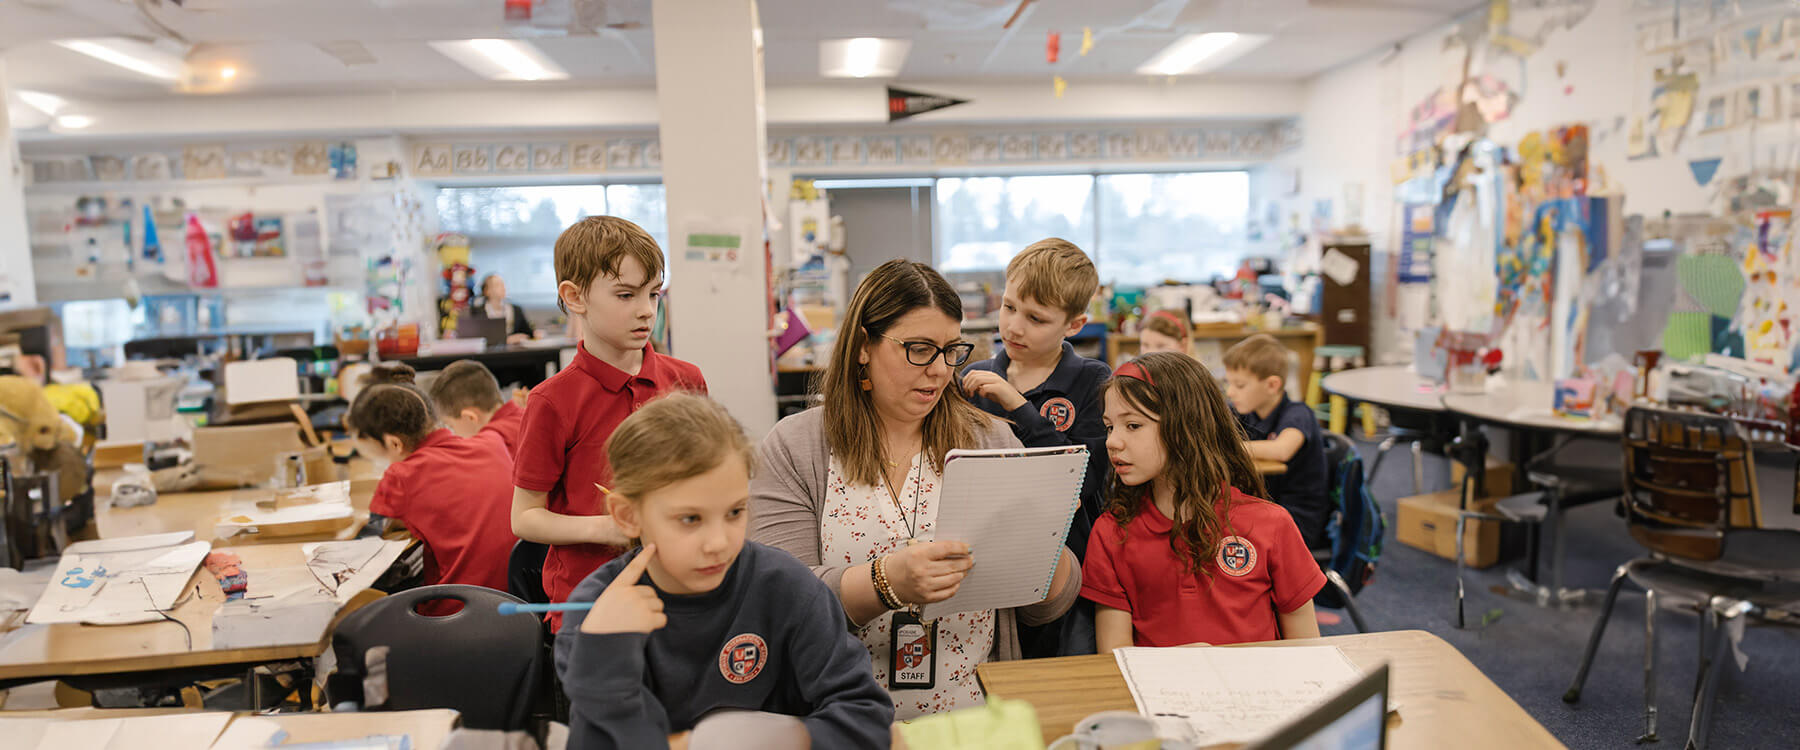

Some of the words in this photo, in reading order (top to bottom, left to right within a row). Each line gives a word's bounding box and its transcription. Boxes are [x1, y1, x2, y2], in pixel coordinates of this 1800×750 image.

[418, 146, 449, 169] Aa
[455, 147, 488, 168] Bb
[495, 145, 529, 169] Cc
[533, 146, 564, 168] Dd
[572, 143, 602, 168] Ee
[900, 672, 925, 680] STAFF
